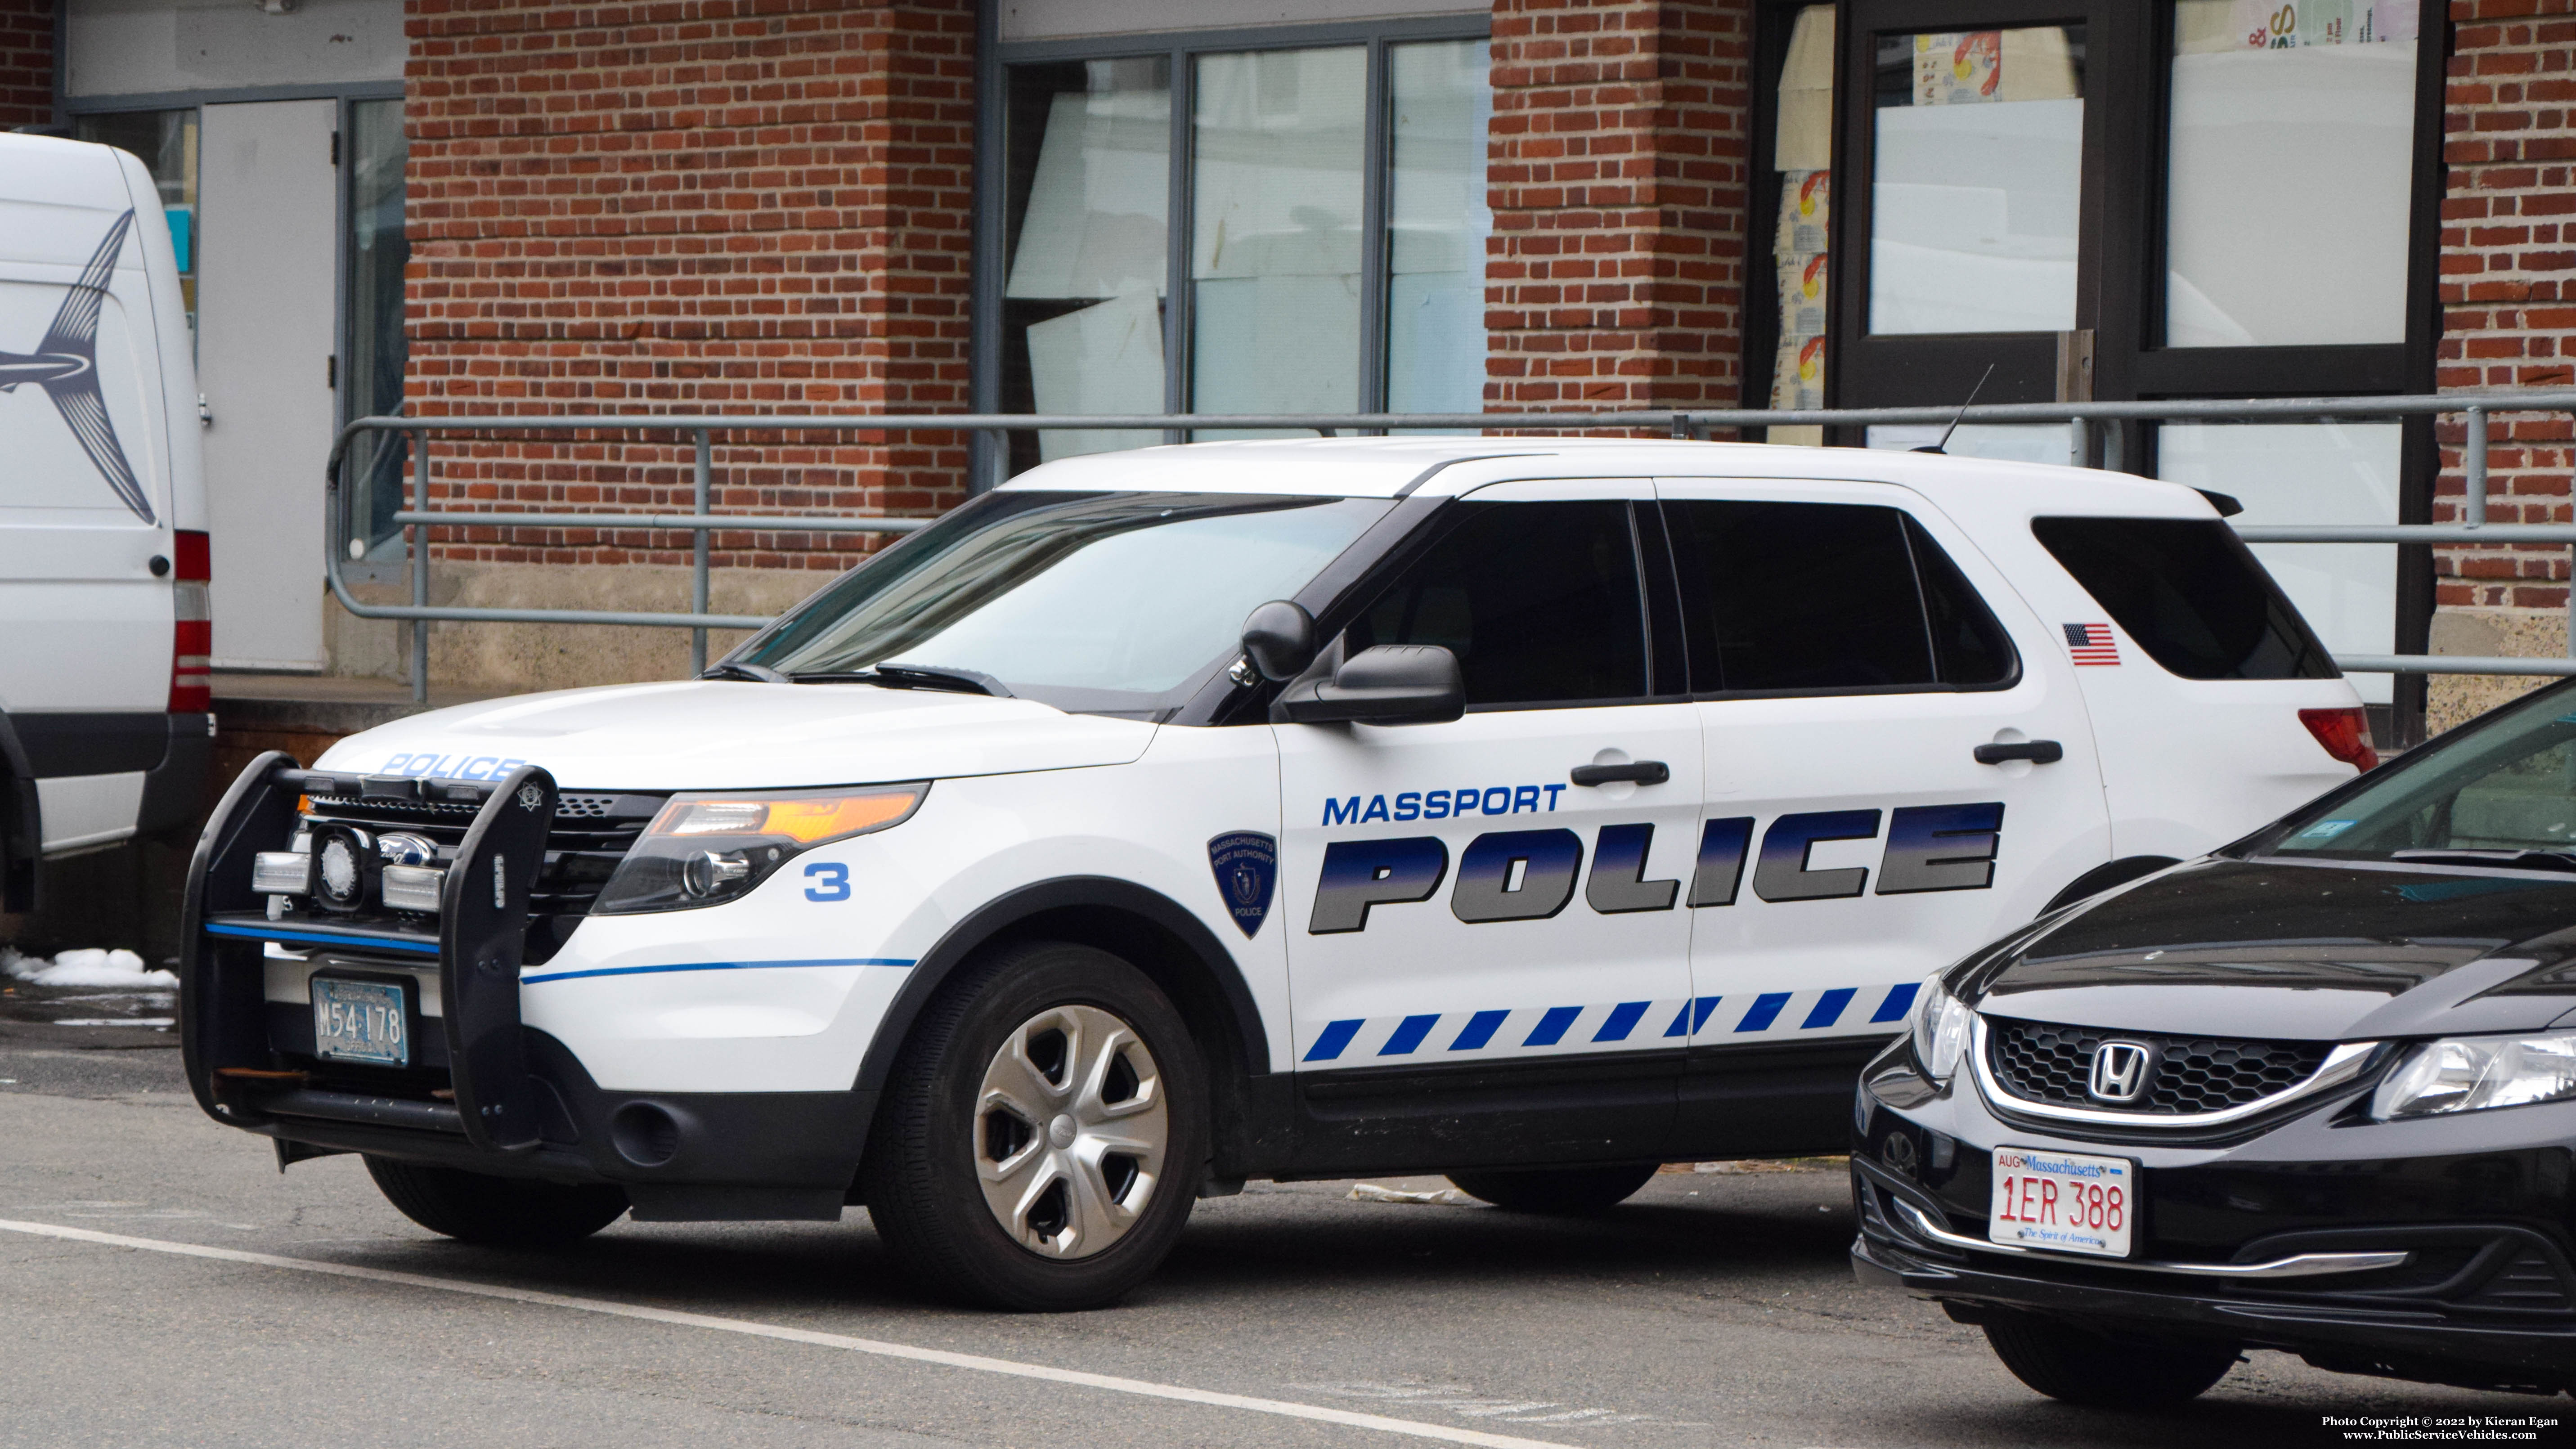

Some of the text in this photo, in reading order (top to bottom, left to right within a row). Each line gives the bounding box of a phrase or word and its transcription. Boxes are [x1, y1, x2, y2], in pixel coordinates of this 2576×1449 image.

[380, 753, 527, 781] POLICE
[1322, 783, 1566, 826] MASSPORT
[1211, 837, 1274, 854] MASSACHUSETTS
[1214, 849, 1275, 868] PORT AUTHORITY
[1308, 801, 2006, 936] POLICE
[803, 862, 851, 902] 3
[1235, 906, 1263, 917] POLICE
[1999, 1155, 2101, 1178] AUG Massachusetts
[2000, 1175, 2124, 1231] 1ER 388
[2024, 1227, 2102, 1246] The Spirit of America
